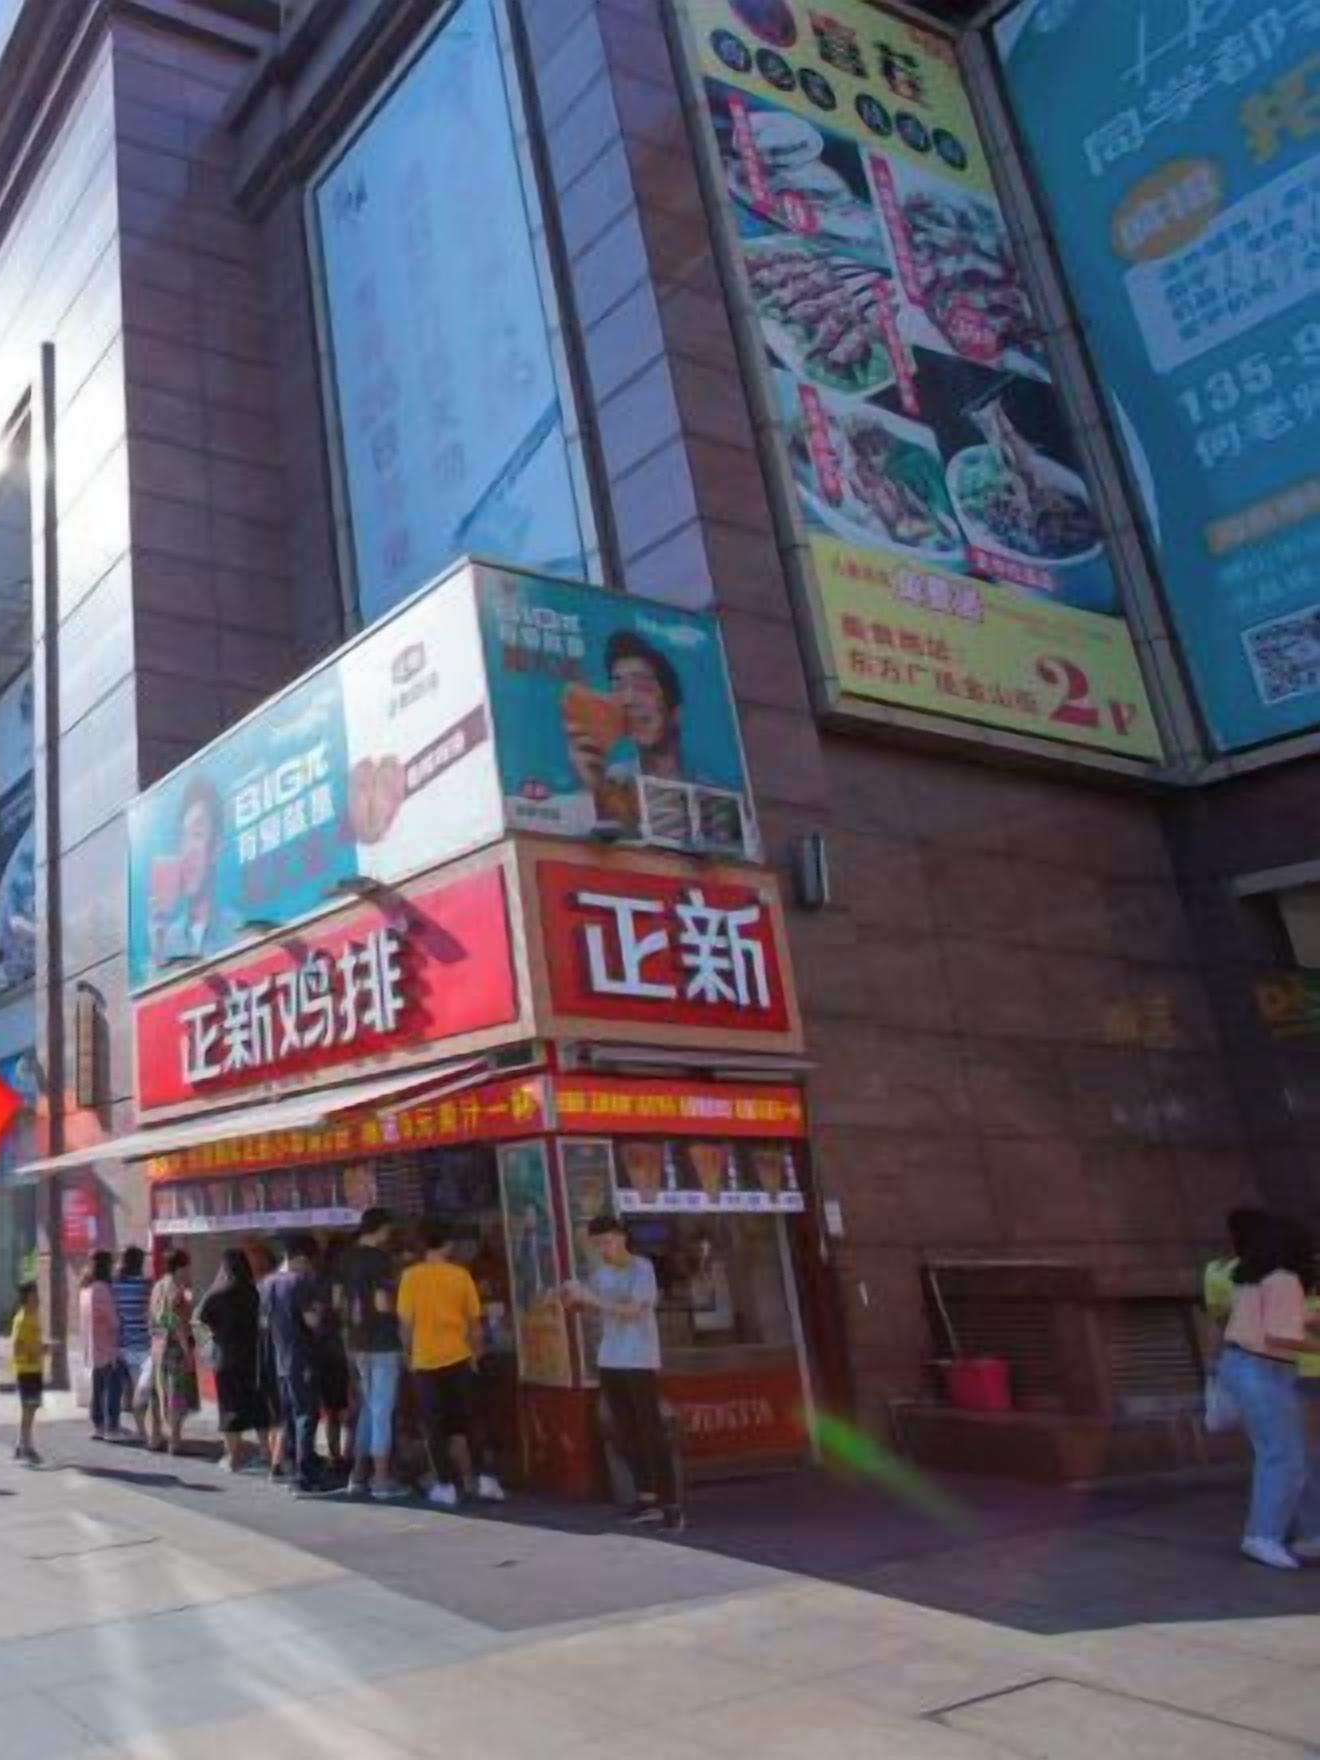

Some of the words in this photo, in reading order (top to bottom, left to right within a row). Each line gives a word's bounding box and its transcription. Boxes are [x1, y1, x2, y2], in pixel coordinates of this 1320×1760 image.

[179, 928, 404, 1084] 正新鸡排
[577, 888, 770, 1009] 正新
